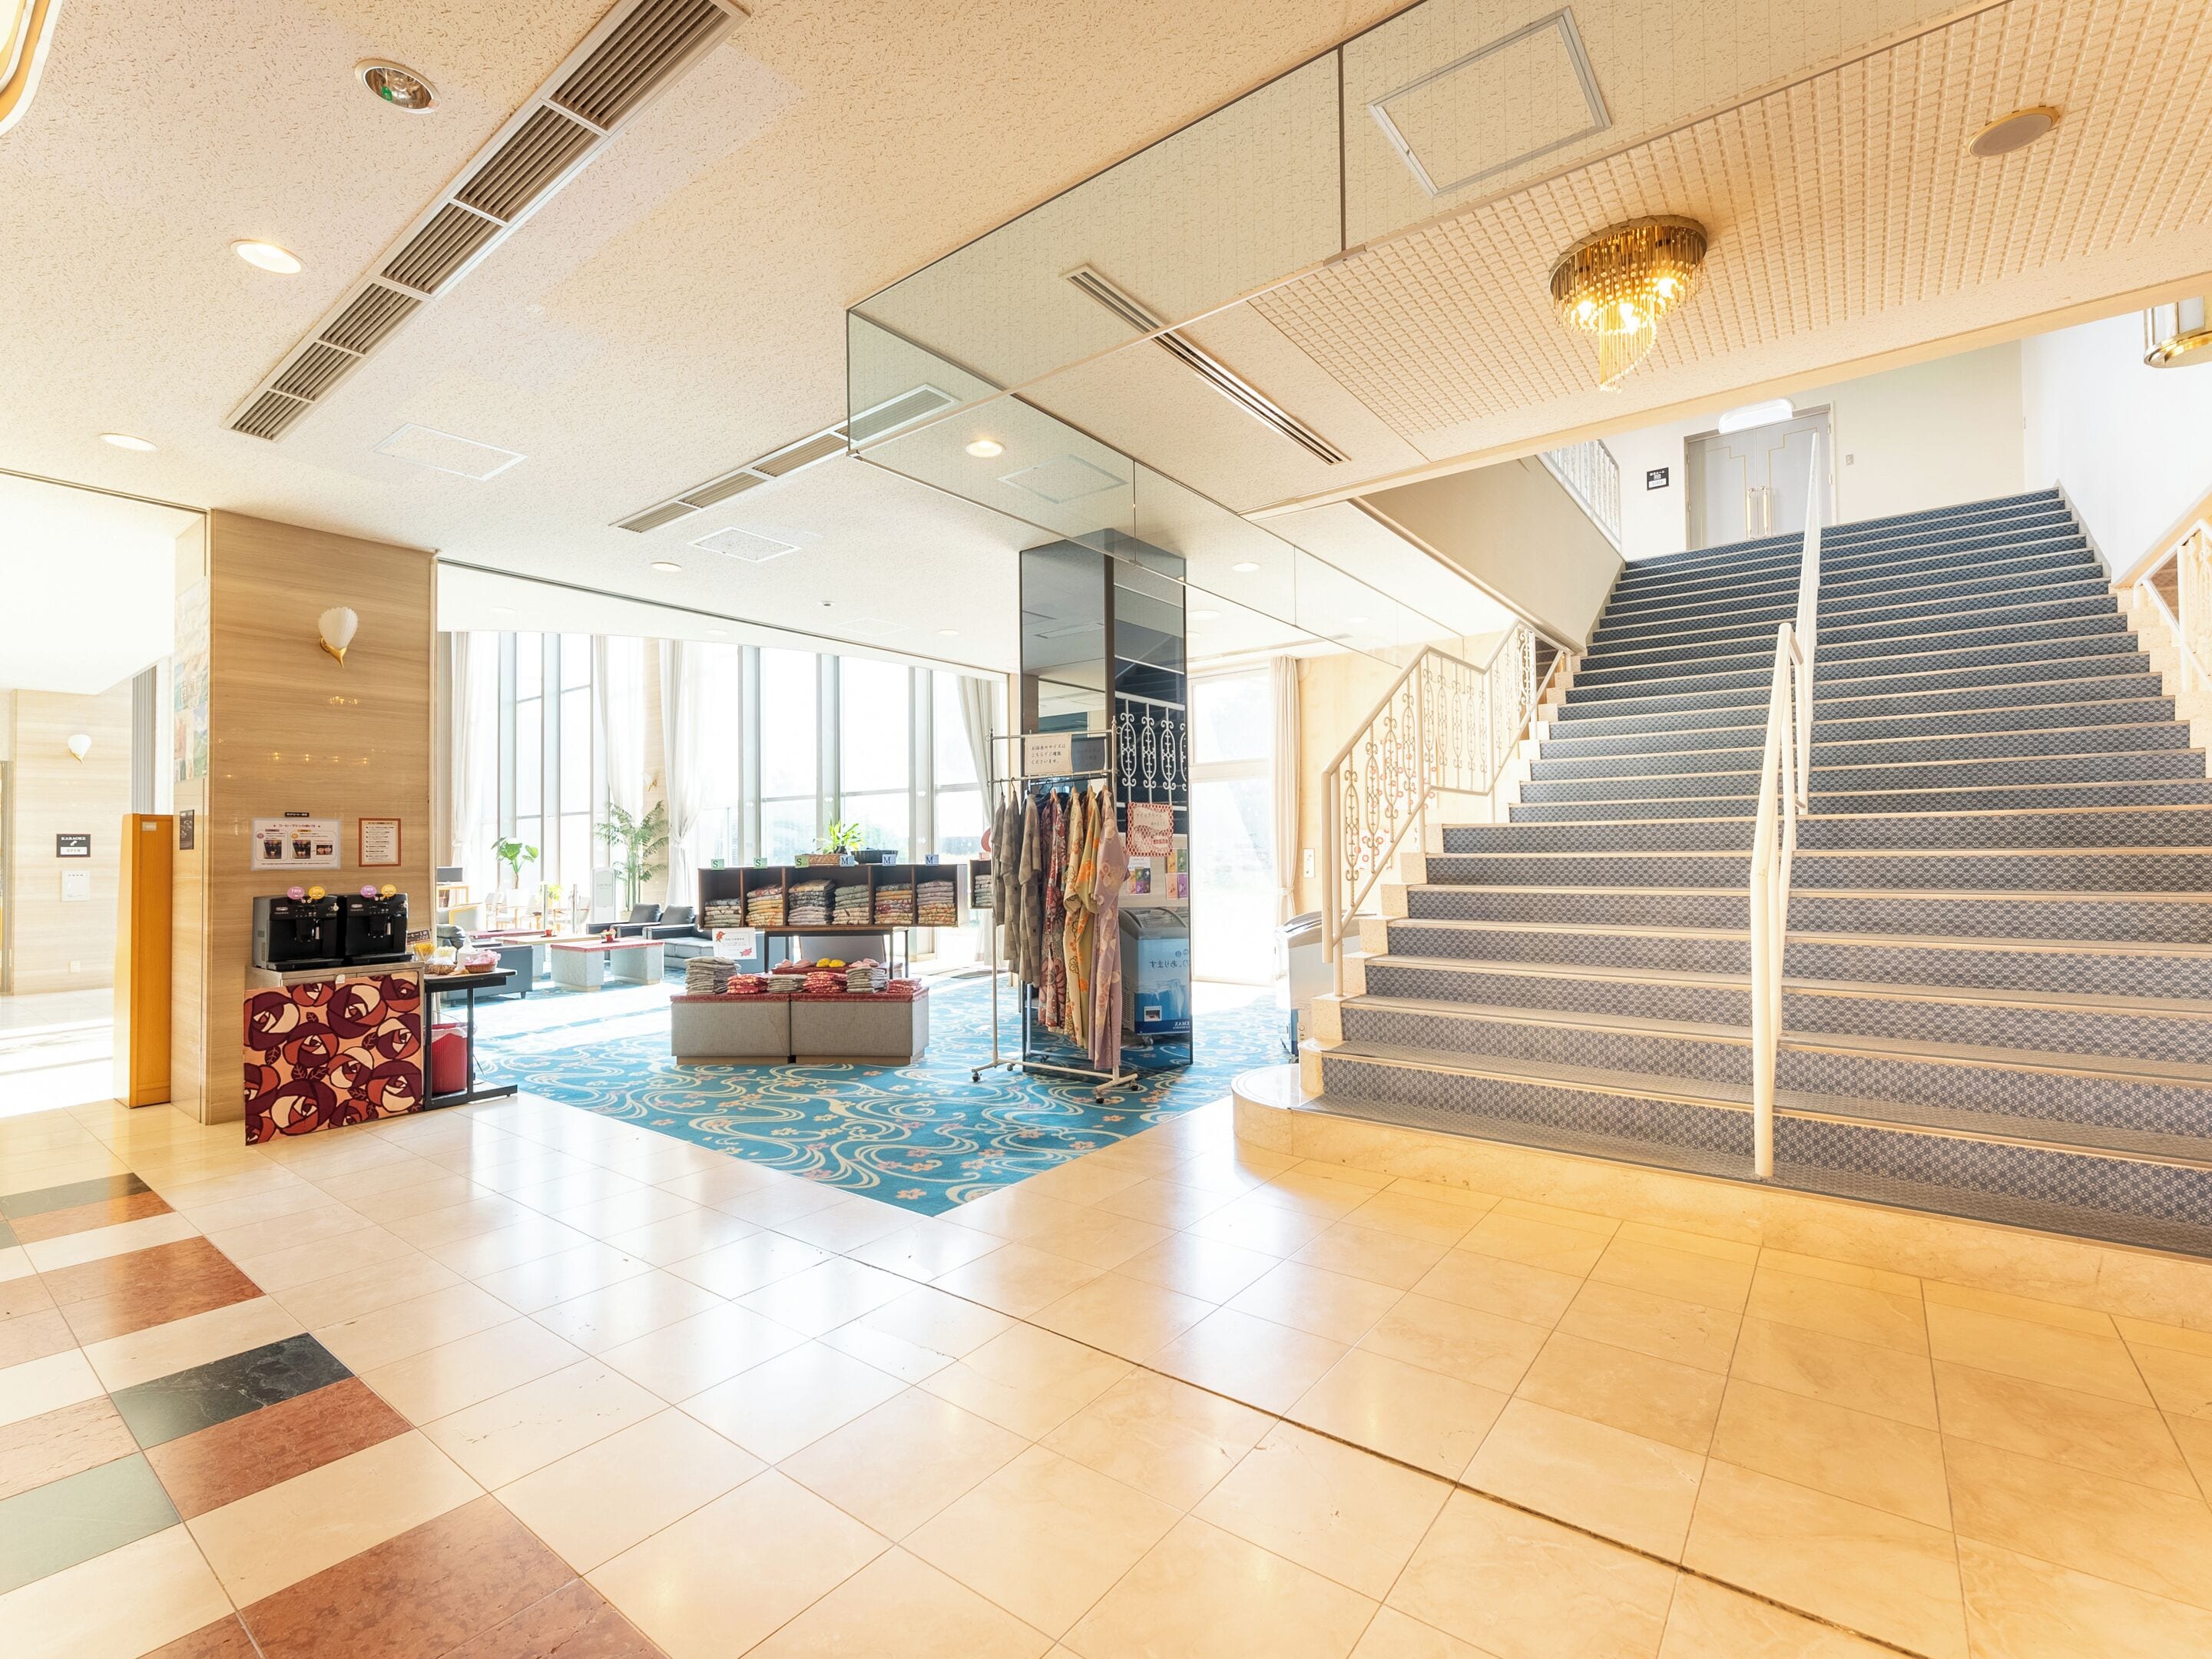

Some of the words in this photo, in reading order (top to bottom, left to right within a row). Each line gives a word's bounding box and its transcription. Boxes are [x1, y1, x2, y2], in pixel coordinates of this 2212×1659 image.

[755, 859, 761, 867] S
[796, 858, 803, 866] S
[841, 856, 849, 865] M
[882, 856, 891, 864] M
